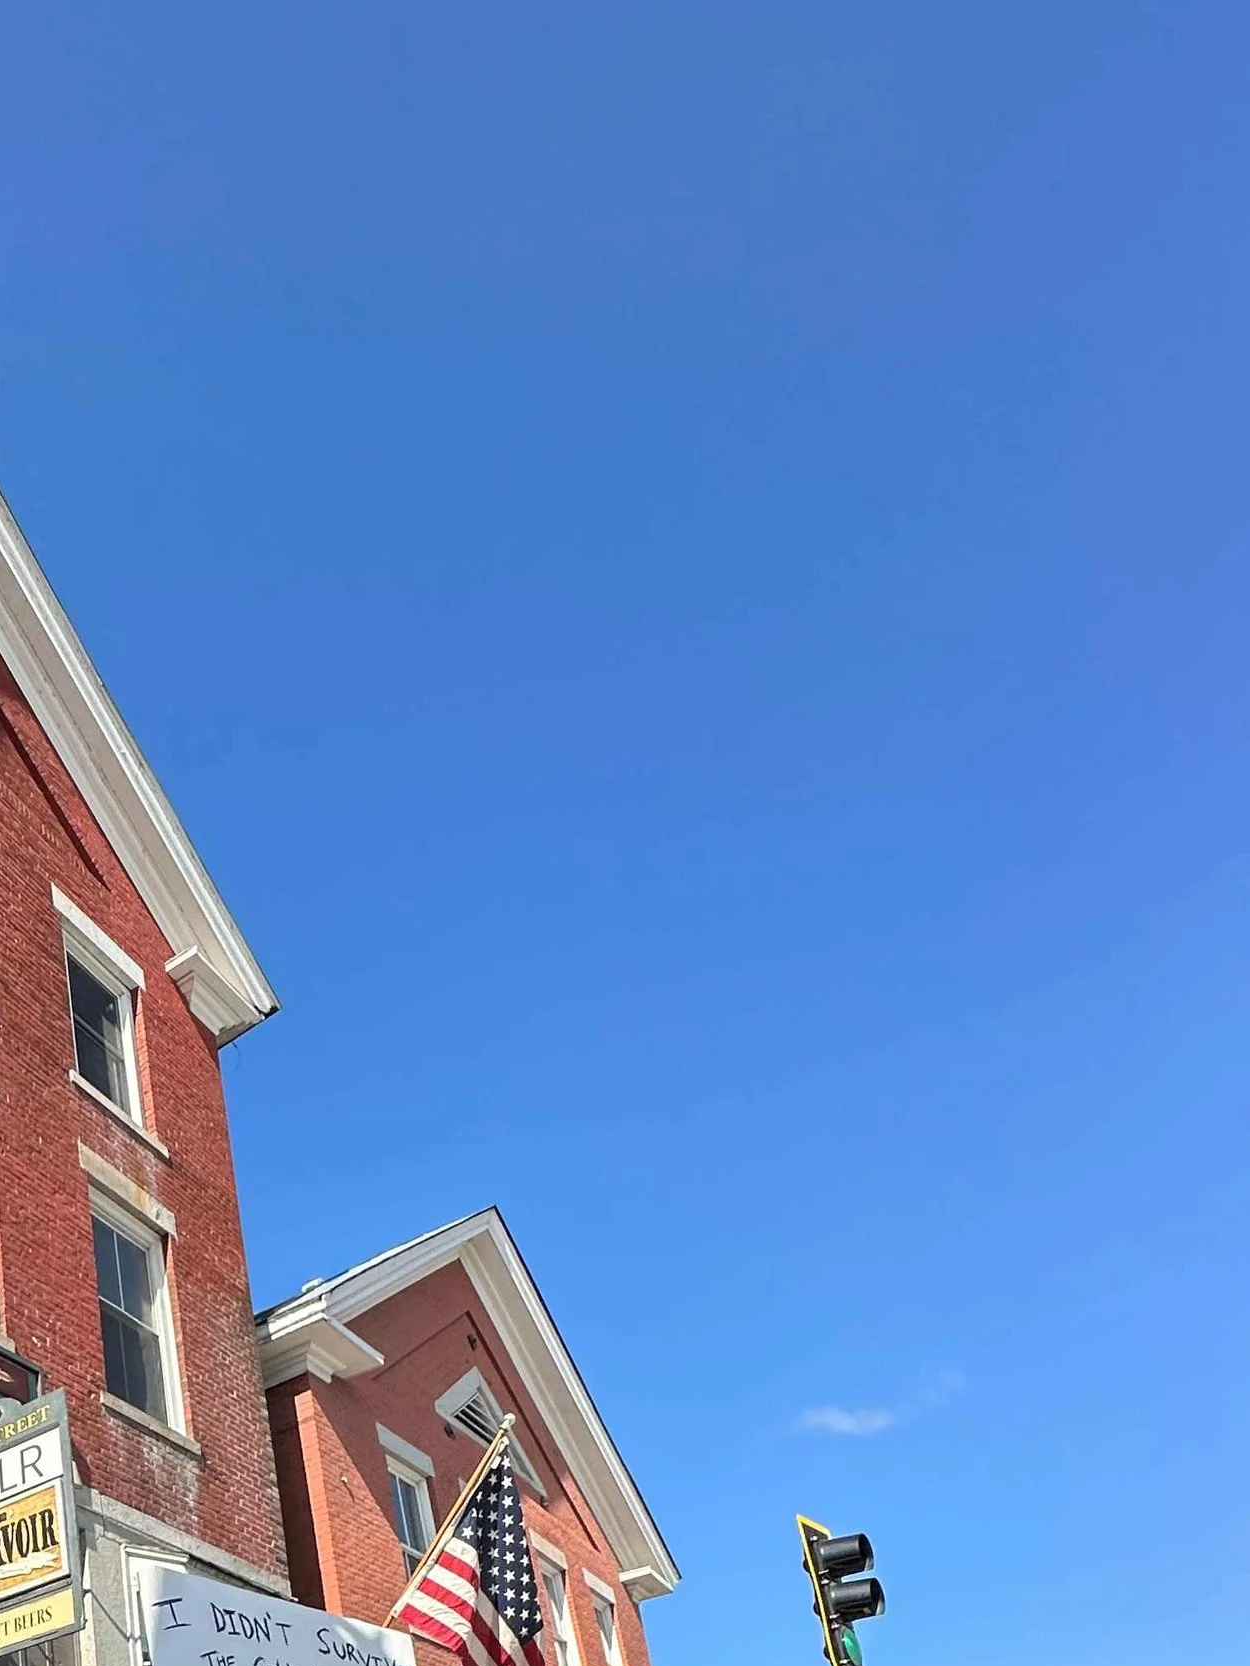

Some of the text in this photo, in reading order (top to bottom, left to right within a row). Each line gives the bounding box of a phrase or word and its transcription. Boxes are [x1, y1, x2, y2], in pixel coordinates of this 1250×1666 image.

[14, 1605, 53, 1633] BEERS
[151, 1598, 192, 1630] I
[210, 1602, 292, 1646] DIDN'T
